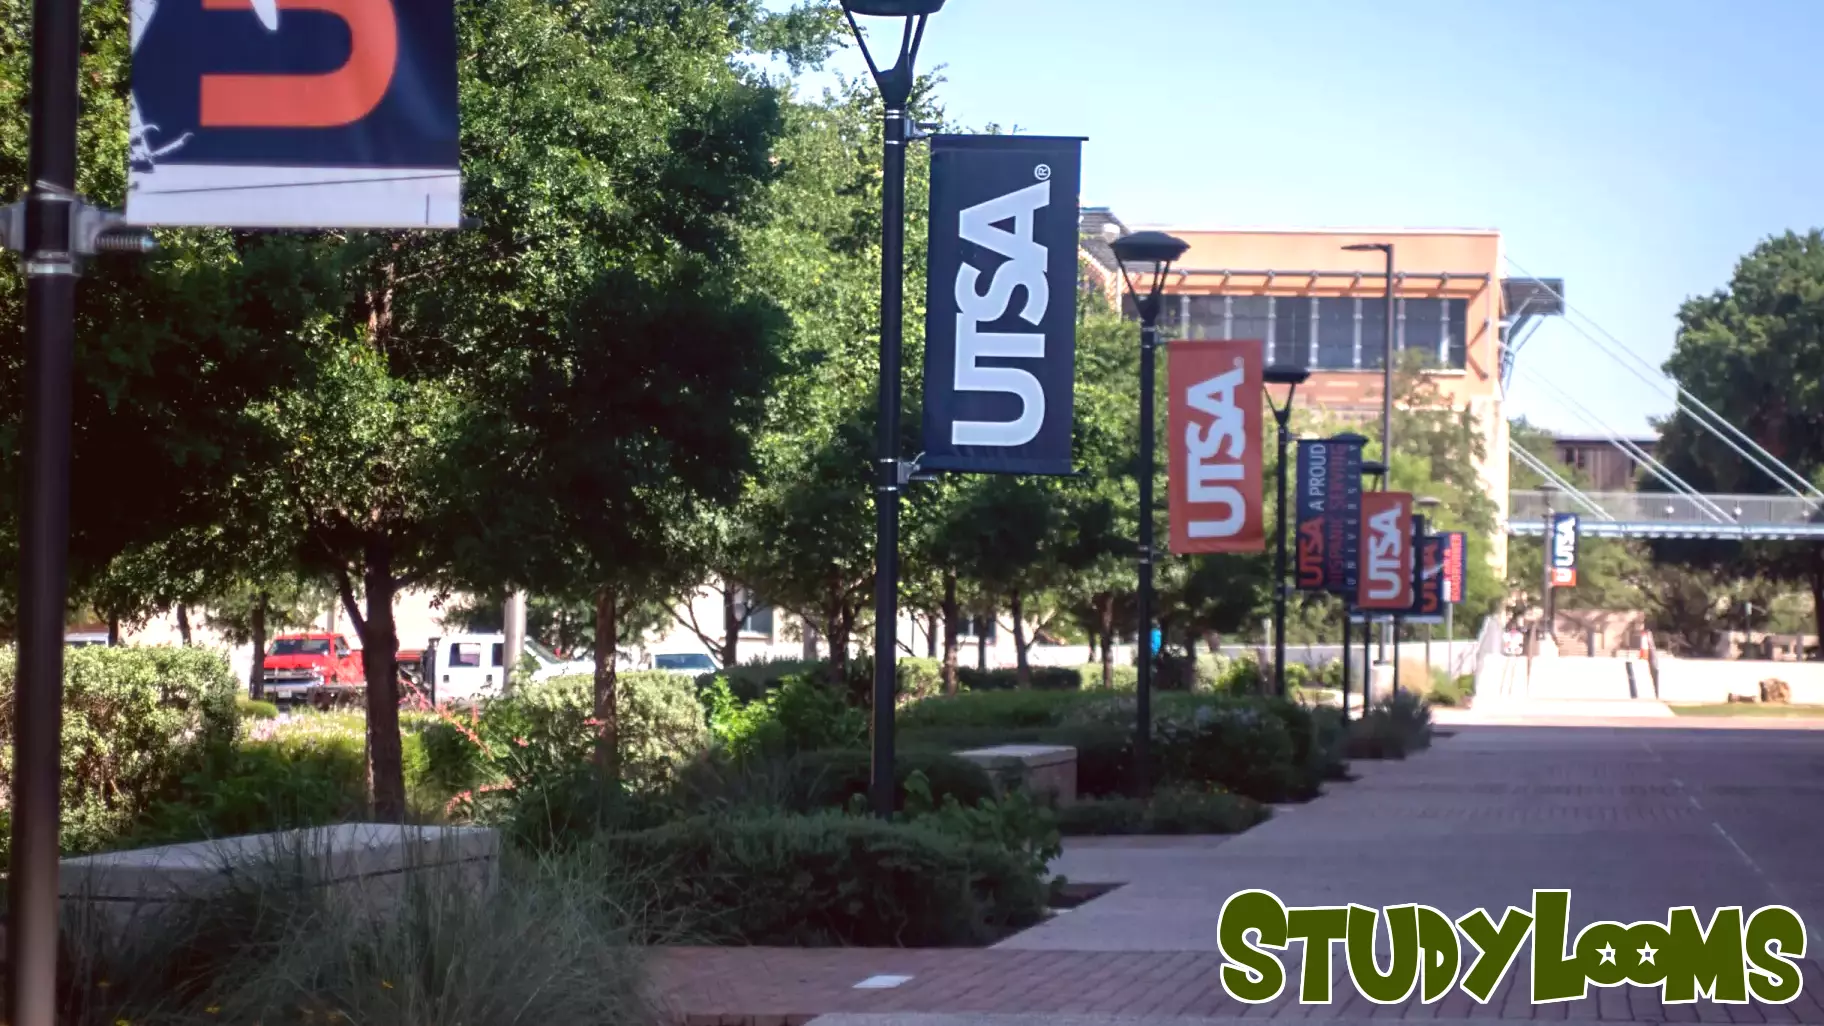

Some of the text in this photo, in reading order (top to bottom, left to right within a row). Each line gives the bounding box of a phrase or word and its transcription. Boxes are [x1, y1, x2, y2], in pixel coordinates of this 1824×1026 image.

[1308, 444, 1326, 512] A PROUD
[1299, 515, 1325, 587] UTSA
[1368, 506, 1402, 600] UTSA
[1555, 516, 1575, 567] UTSA
